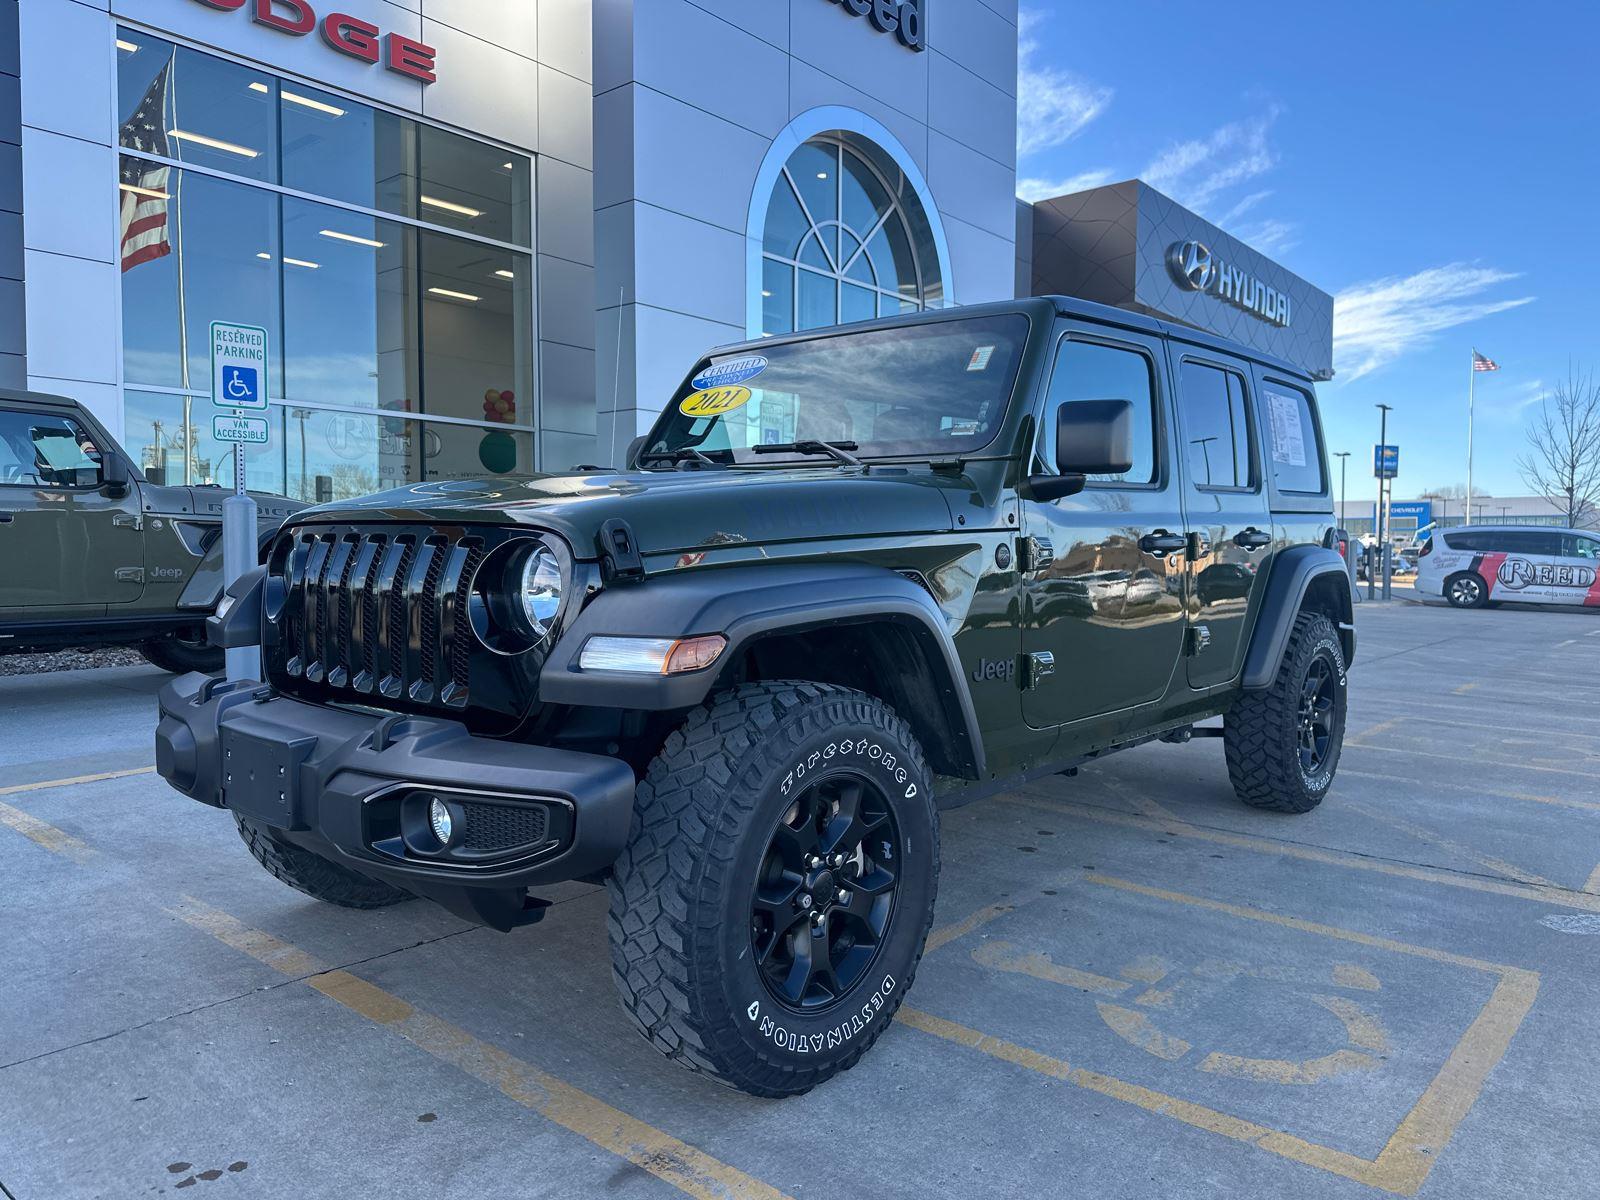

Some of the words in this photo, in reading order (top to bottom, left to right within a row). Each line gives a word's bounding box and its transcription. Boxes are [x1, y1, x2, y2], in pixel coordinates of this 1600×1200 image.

[1219, 260, 1290, 327] HYUNDAI
[216, 329, 262, 346] RESERVED
[216, 345, 263, 360] PARKING
[703, 358, 762, 378] CERTIFIED
[688, 389, 741, 411] 2021
[216, 429, 265, 440] ACCESSIBLE
[233, 420, 249, 429] VAN
[150, 566, 183, 578] Jeep
[1500, 558, 1592, 587] REED
[972, 658, 1015, 682] Jeep
[780, 738, 907, 796] Firestone
[759, 974, 896, 1053] DESTINATION
